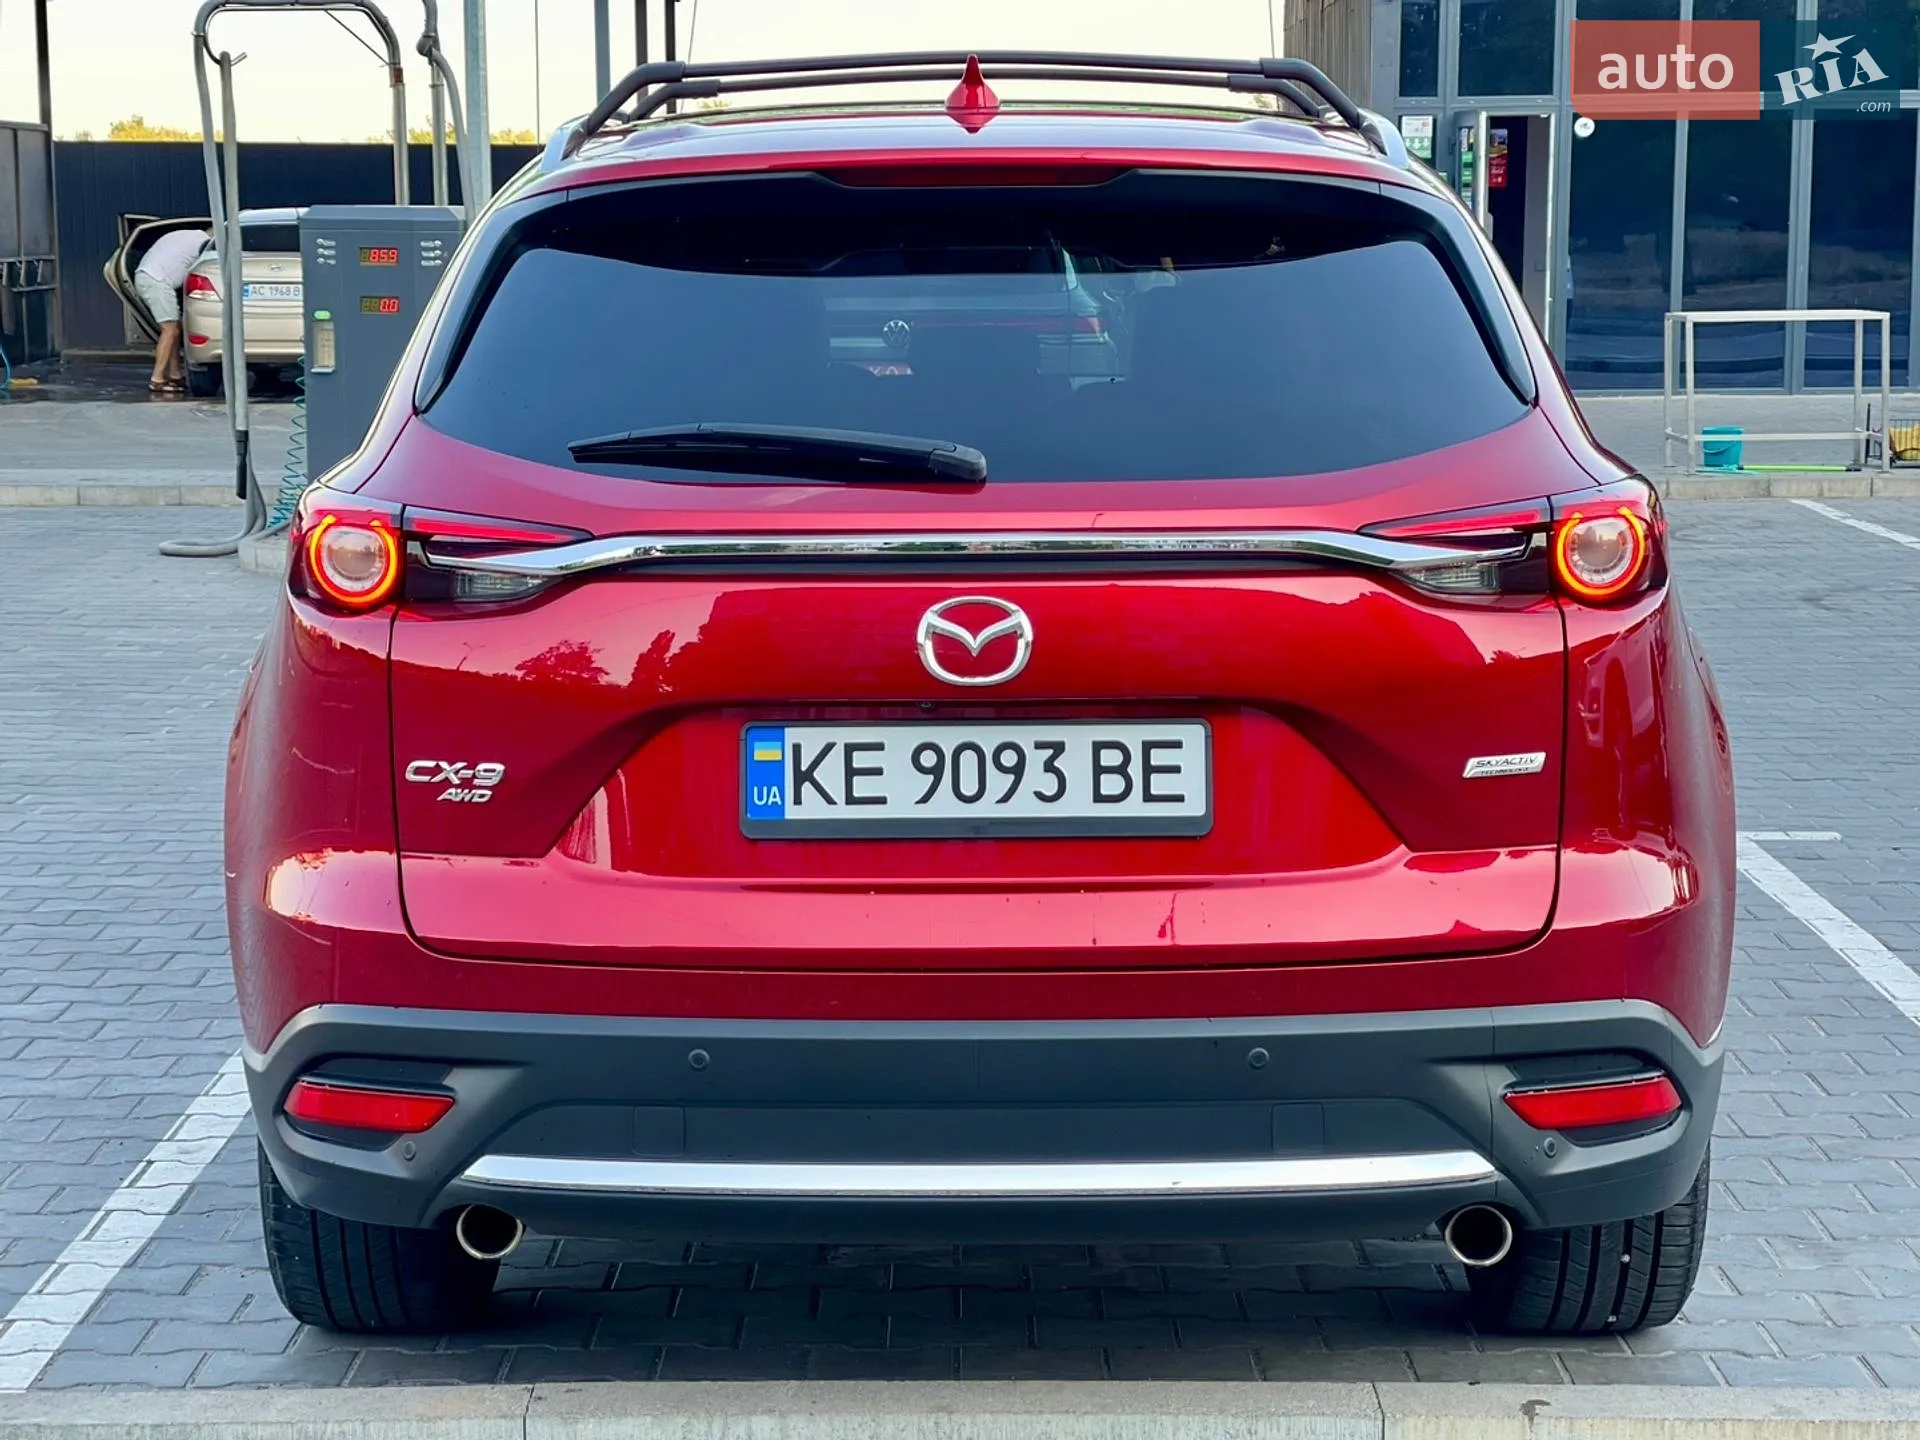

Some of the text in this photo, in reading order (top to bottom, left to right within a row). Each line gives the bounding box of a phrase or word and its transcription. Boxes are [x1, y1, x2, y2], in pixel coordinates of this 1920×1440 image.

[251, 285, 265, 296] AC
[269, 285, 291, 296] 1968
[1475, 755, 1538, 768] SKYACTIV
[405, 760, 505, 786] CX-9
[791, 739, 1186, 806] KE 9093 BE
[436, 787, 493, 803] AWD
[753, 786, 782, 806] UA
